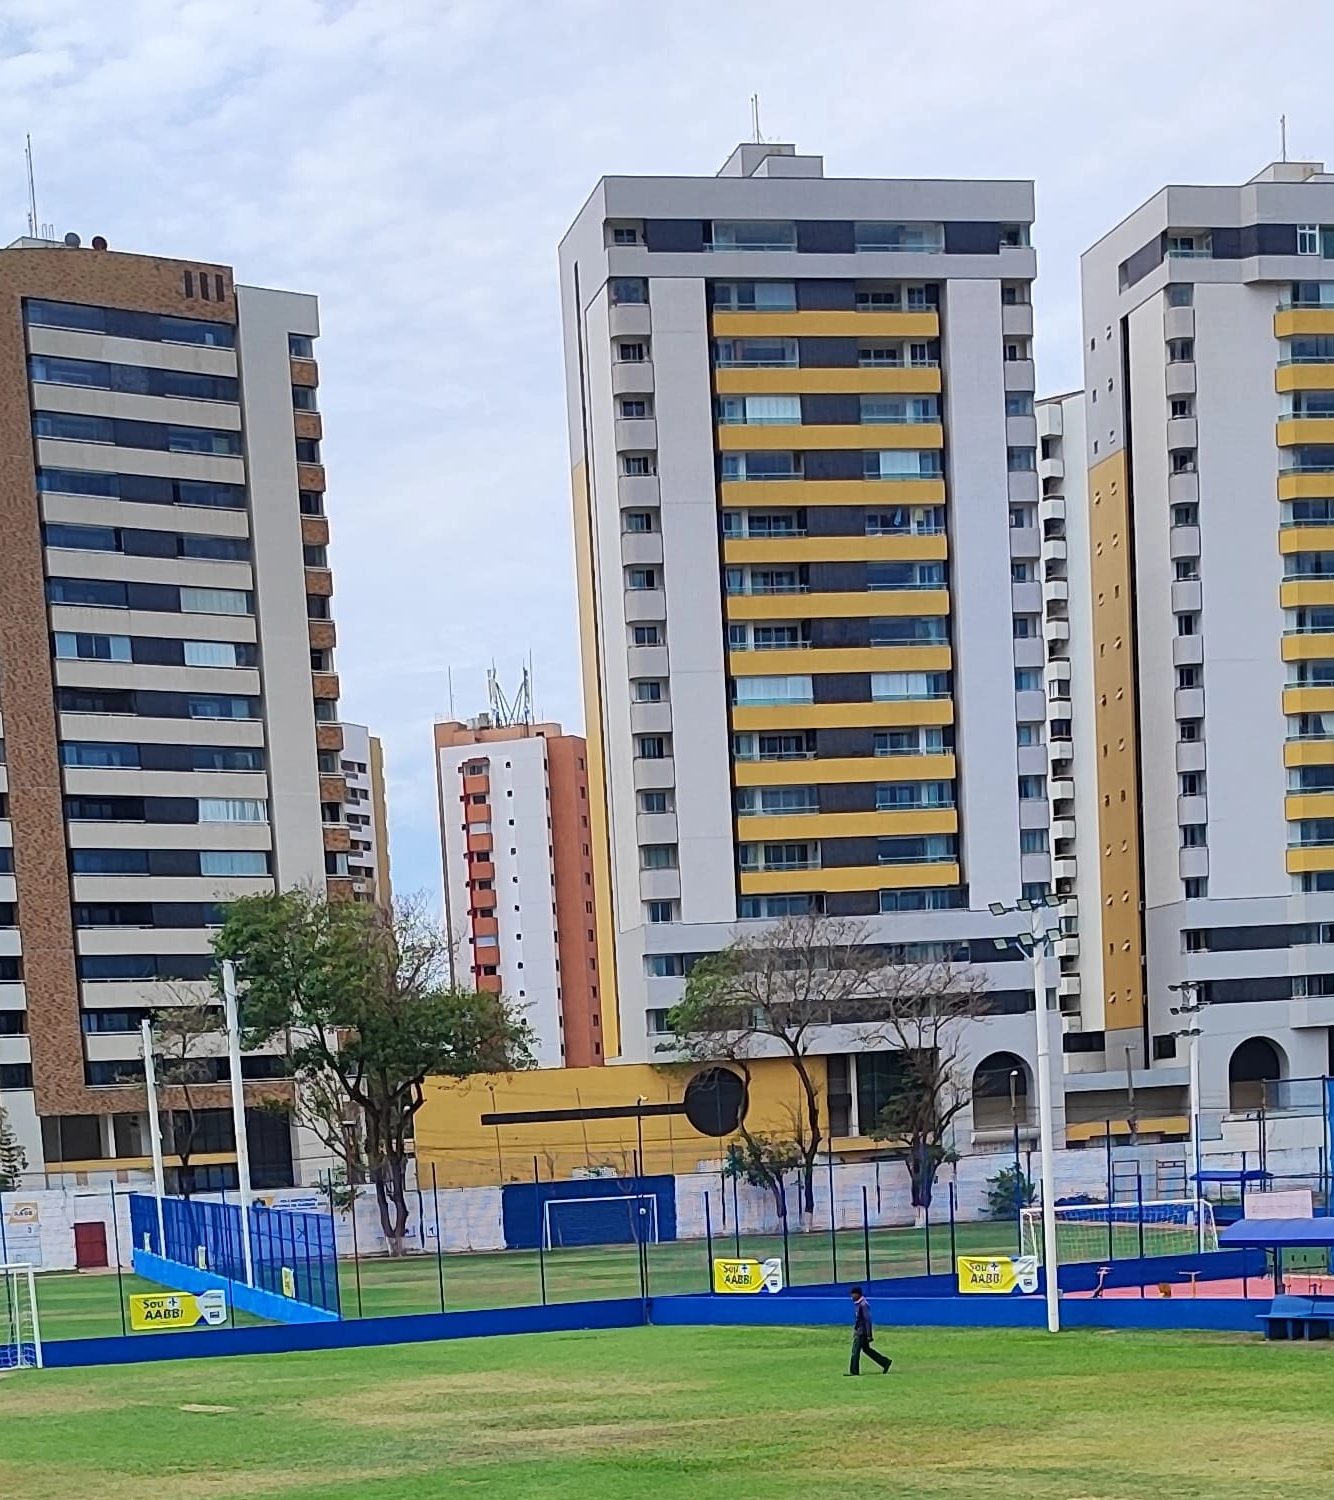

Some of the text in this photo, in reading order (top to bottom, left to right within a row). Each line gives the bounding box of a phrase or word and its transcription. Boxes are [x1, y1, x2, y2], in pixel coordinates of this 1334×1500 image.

[969, 1262, 987, 1272] Sou
[142, 1299, 164, 1310] Sou
[144, 1308, 184, 1321] AABB!
